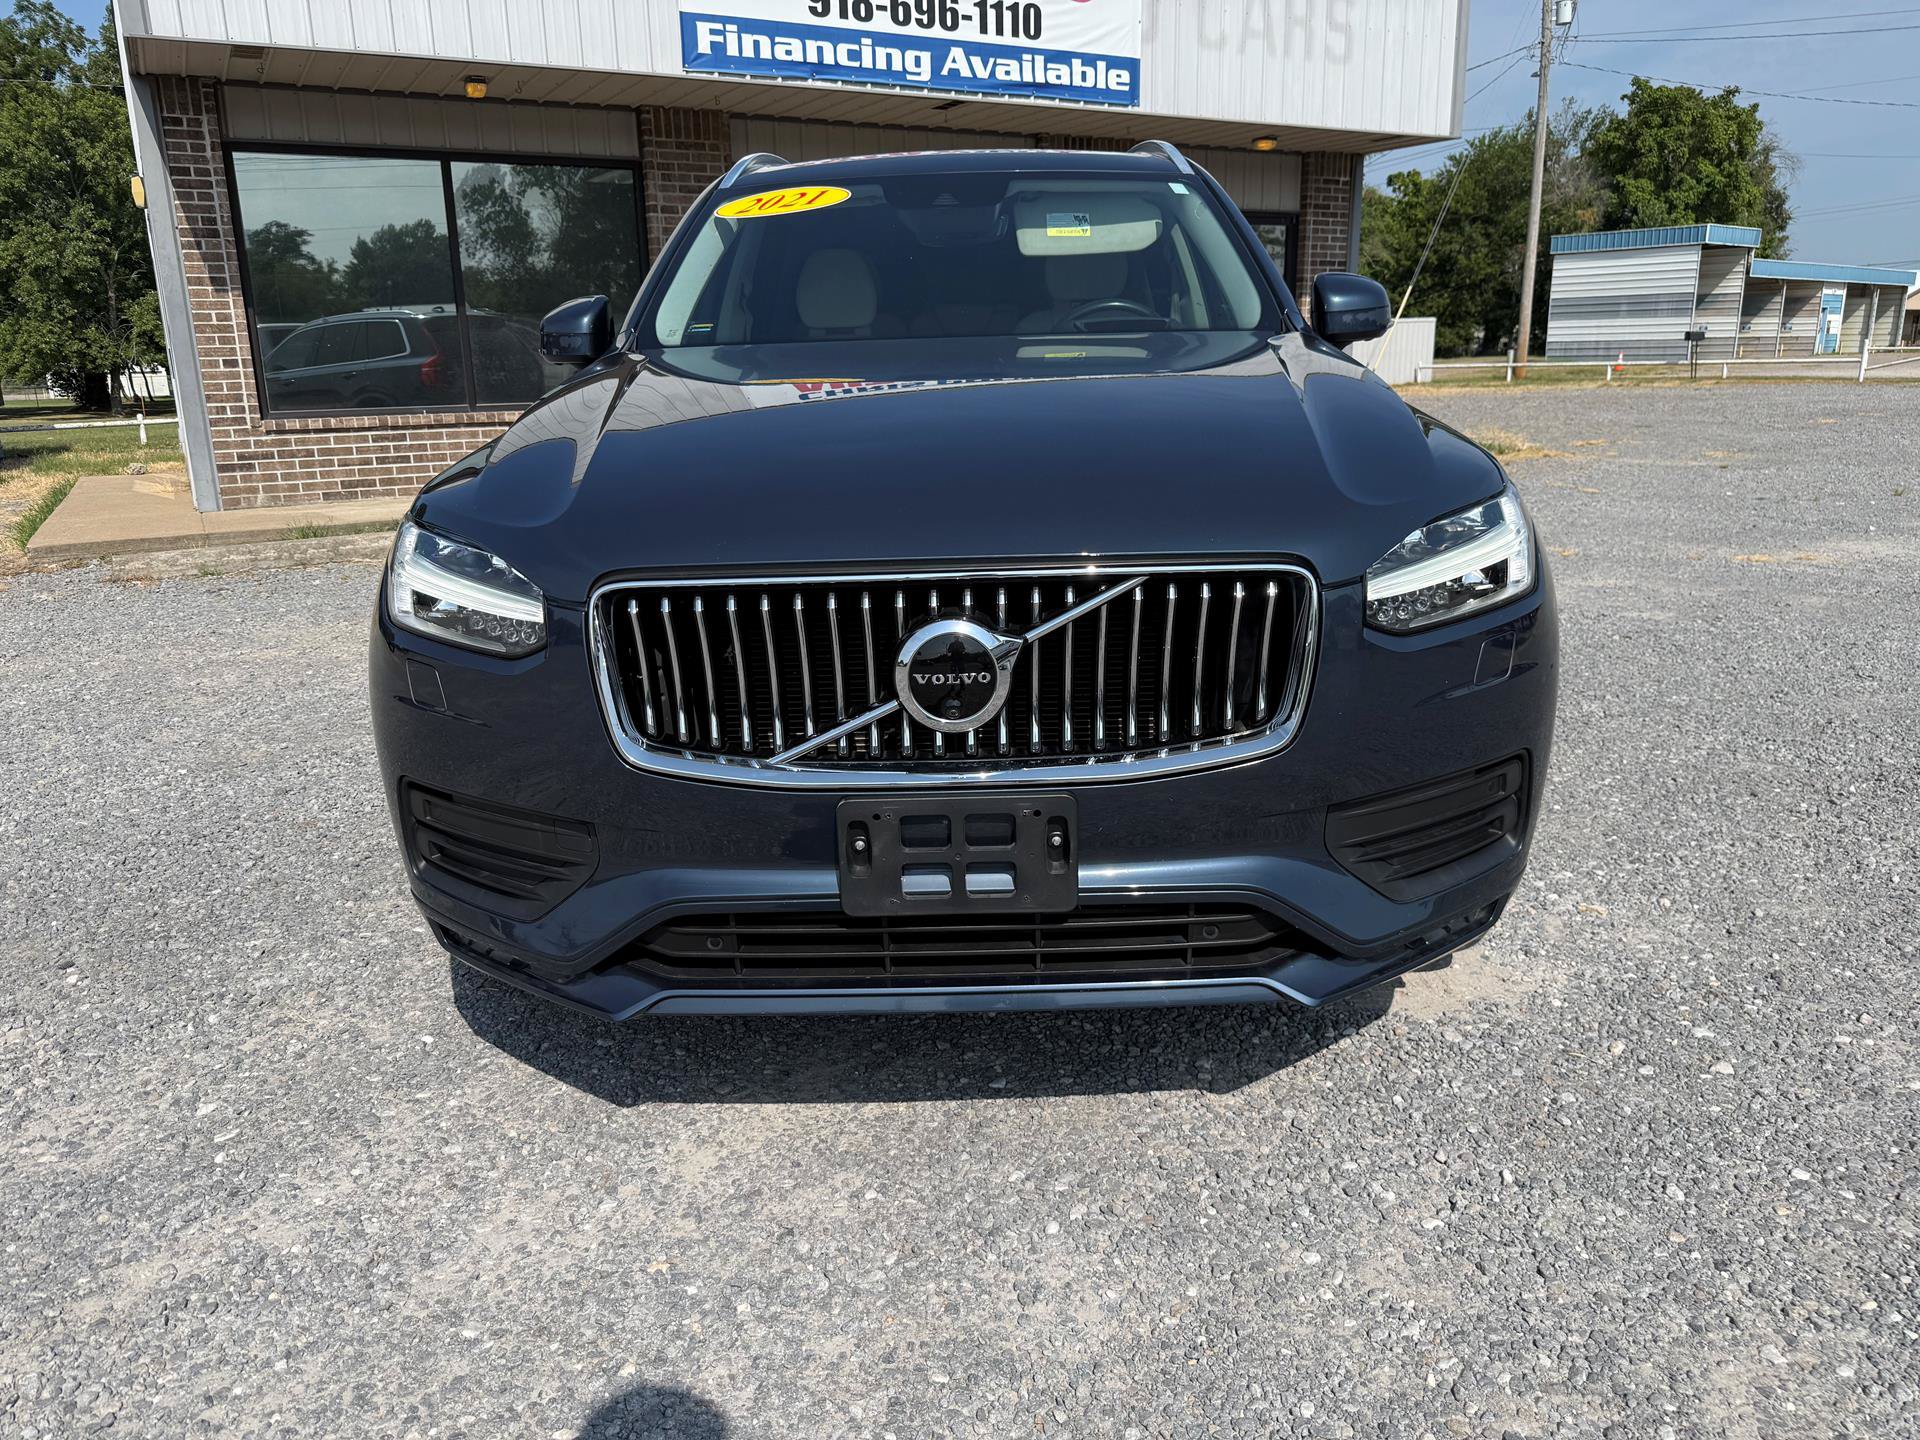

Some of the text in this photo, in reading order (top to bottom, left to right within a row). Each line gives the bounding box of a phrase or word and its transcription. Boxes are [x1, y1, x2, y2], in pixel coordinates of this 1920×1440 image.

[695, 21, 1131, 92] Financing Available
[735, 189, 830, 215] 2021
[912, 671, 992, 685] VOLVO
